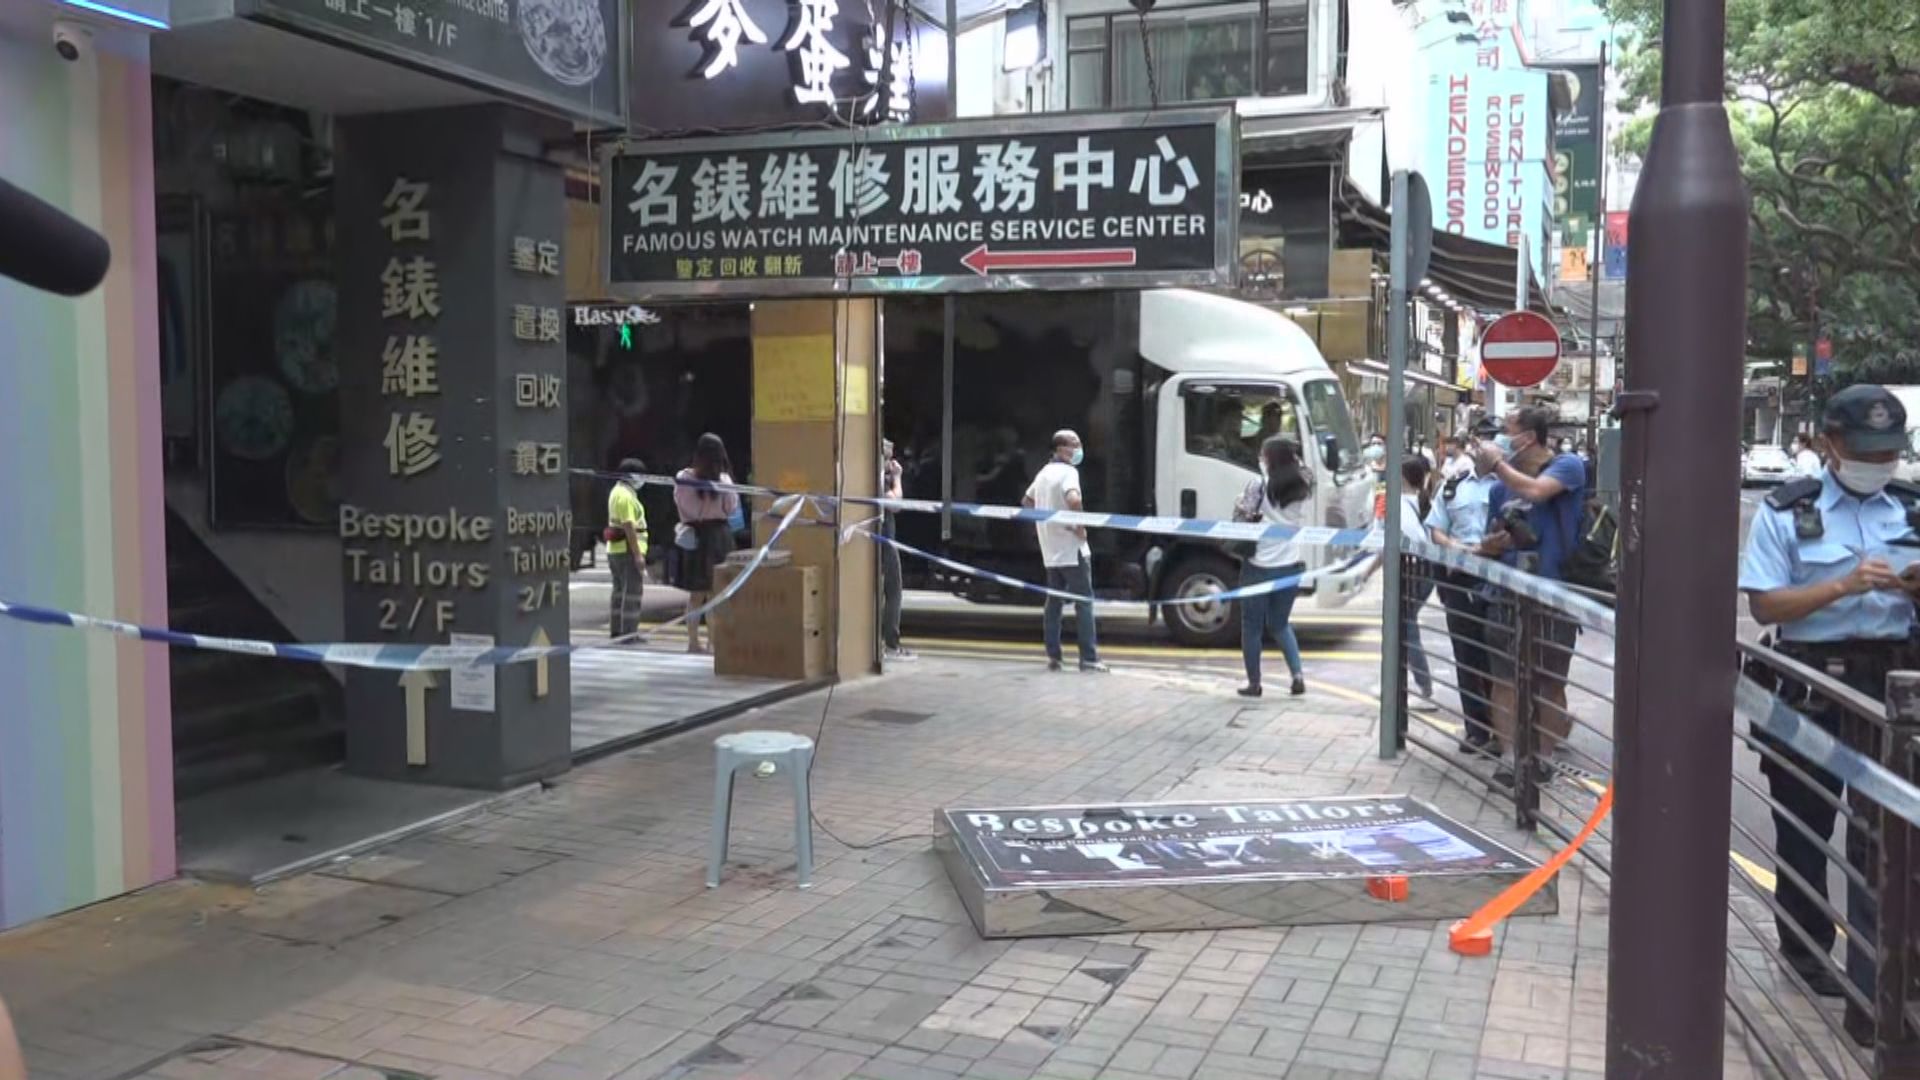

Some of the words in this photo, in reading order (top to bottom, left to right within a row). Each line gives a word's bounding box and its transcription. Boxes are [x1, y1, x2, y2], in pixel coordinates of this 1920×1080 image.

[628, 133, 1201, 226] 名錶維修服務中心
[1483, 95, 1502, 229] ROSEWOOD
[1506, 93, 1525, 246] FURNITURE
[622, 228, 716, 252] FAMOUS
[721, 225, 803, 249] WATCH
[807, 219, 984, 248] MAINTENANCE
[988, 216, 1096, 241] SERVICE
[1102, 213, 1207, 237] CENTER
[720, 256, 758, 277] 回收
[763, 254, 803, 276] 翻新
[379, 176, 442, 478] 名錶維修
[511, 303, 561, 344] 置換
[515, 373, 561, 410] 回收
[339, 503, 492, 546] Bespoke
[506, 505, 573, 534] Bespoke
[344, 548, 490, 588] Tailors
[509, 545, 572, 575] Tailors
[967, 808, 1199, 840] Bespoke
[1211, 801, 1405, 825] Tailors
